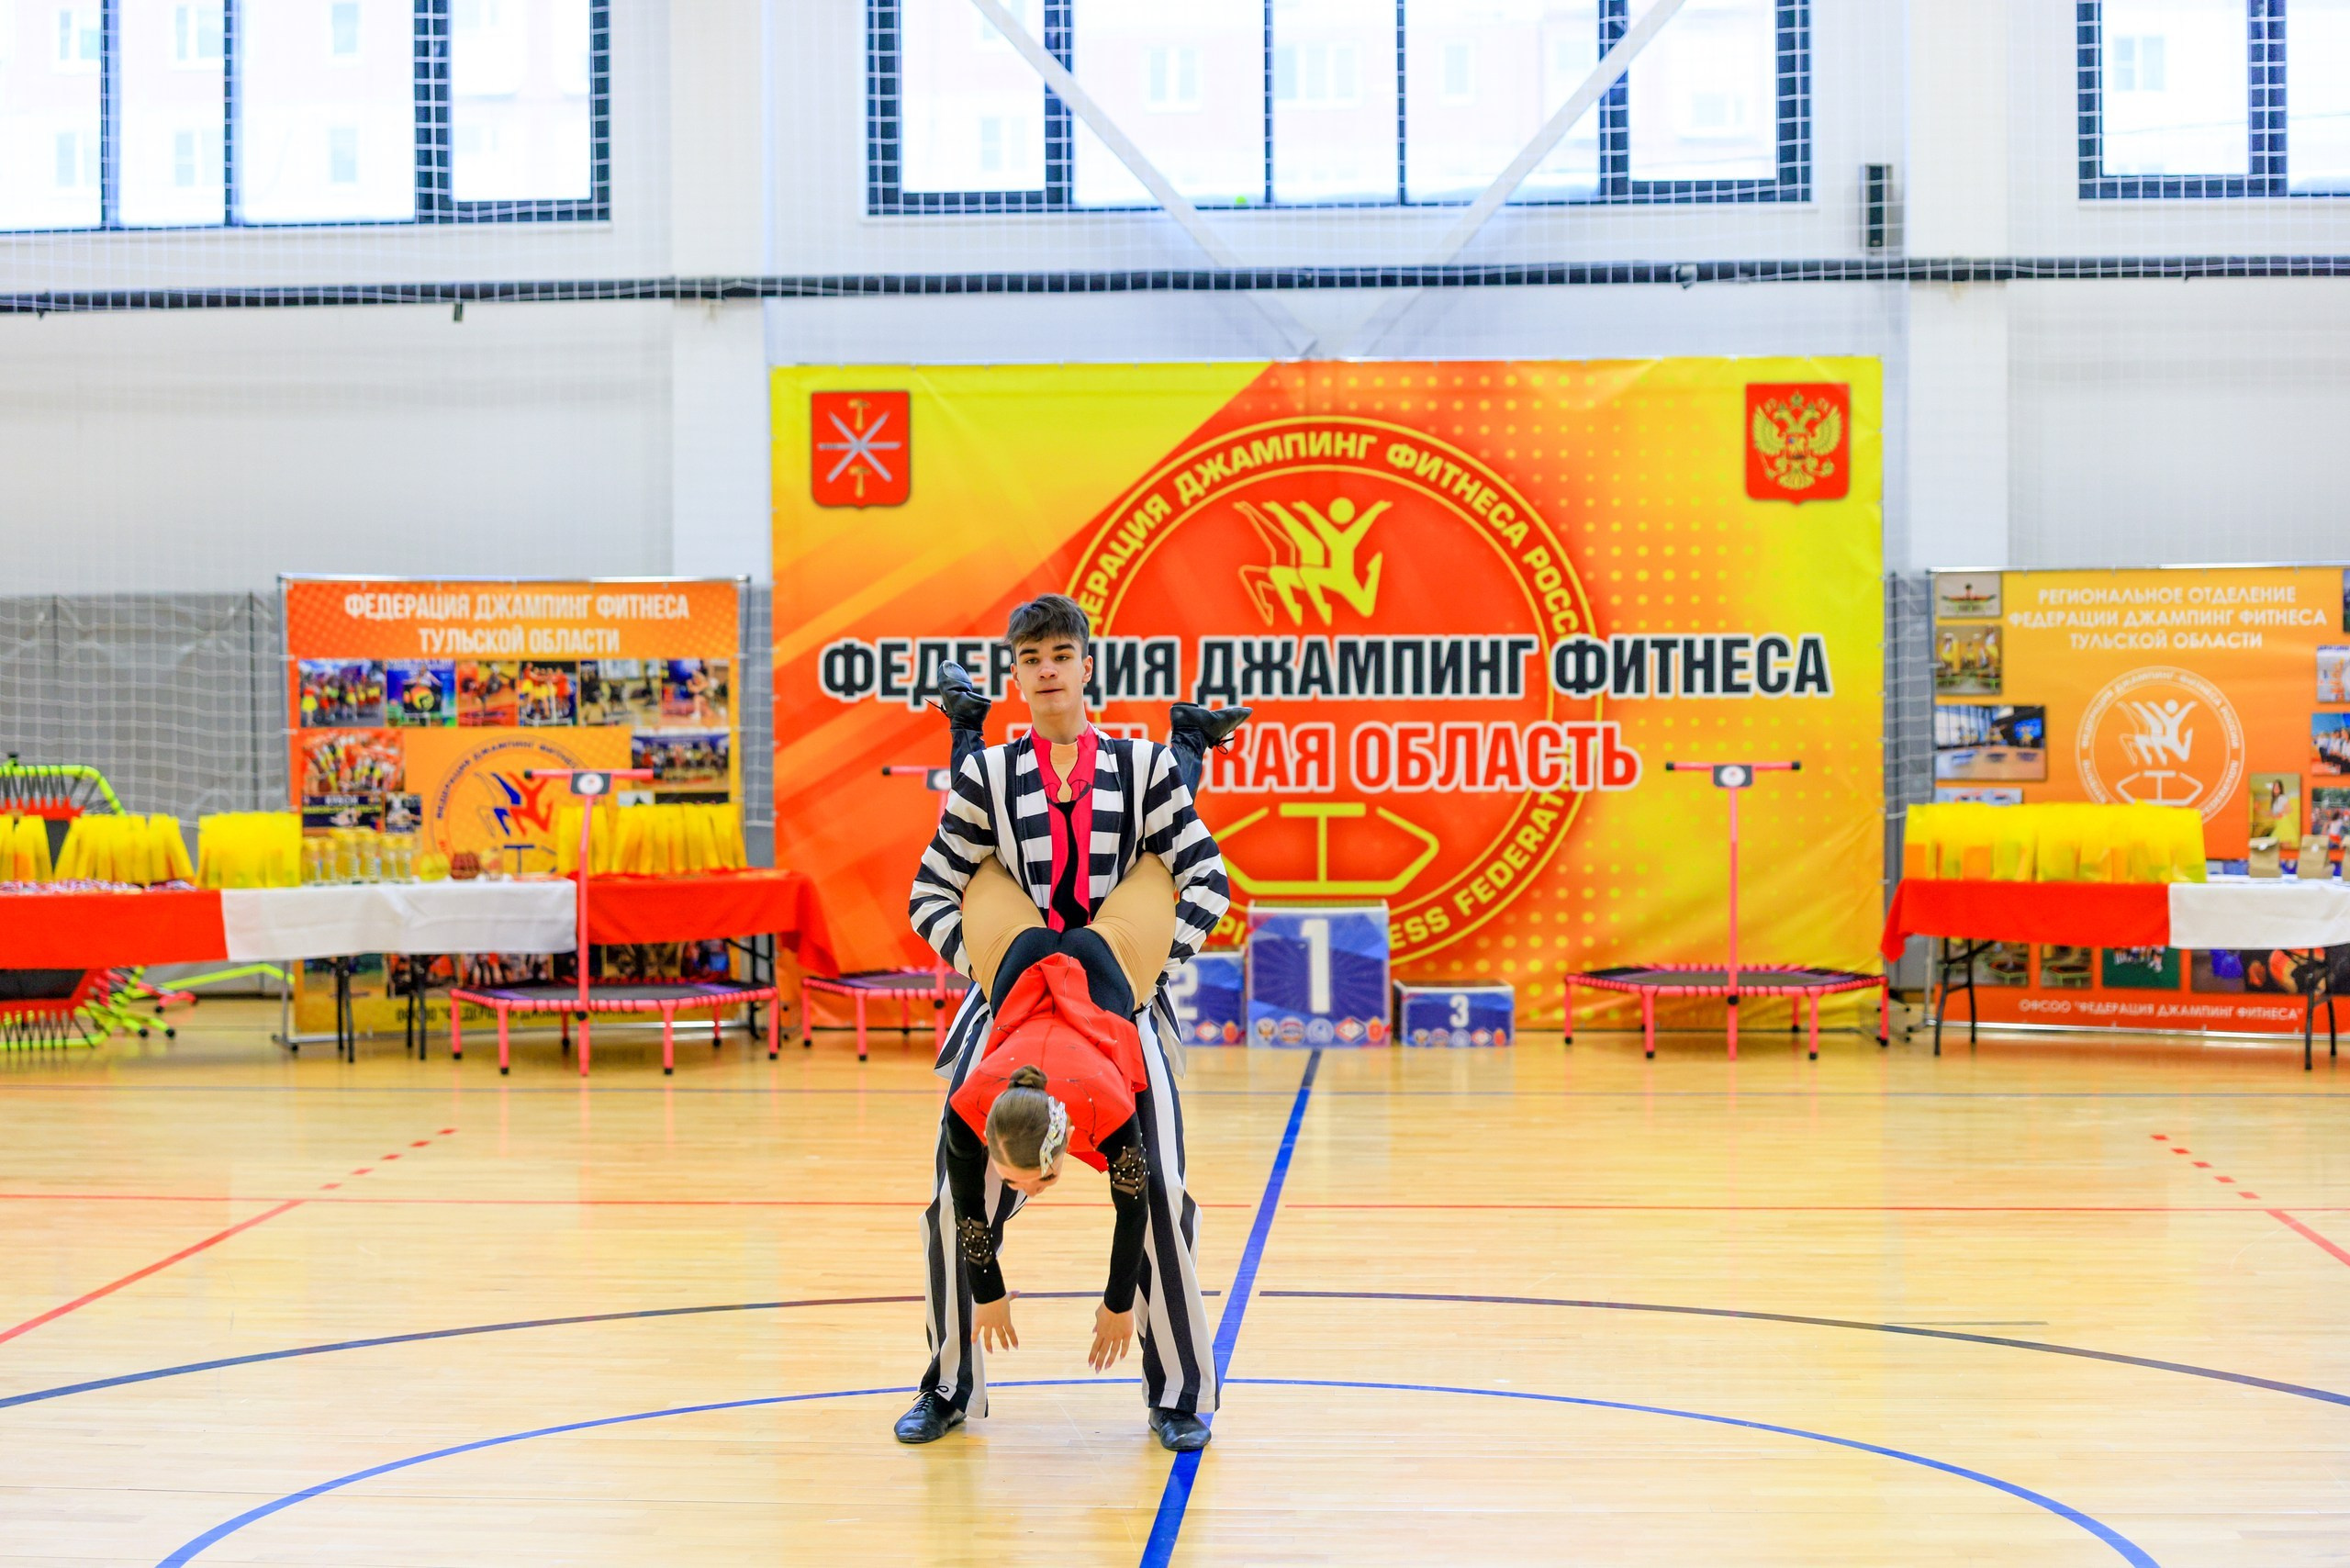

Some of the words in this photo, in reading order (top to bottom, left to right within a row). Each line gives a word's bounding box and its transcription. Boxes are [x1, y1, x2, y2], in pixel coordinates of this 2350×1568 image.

[1173, 431, 1378, 507] ДЖАМПИНГ
[1385, 443, 1530, 549] ФИТНЕСА
[1521, 543, 1581, 641] РОСС
[343, 593, 470, 621] ФЕДЕРАЦИЯ
[473, 593, 592, 621] ДЖАМПИНГ
[596, 592, 689, 620] ФИТНЕСА
[2037, 587, 2188, 606] РЕГИОНАЛЬНОЕ
[2192, 586, 2297, 605] ОТДЕЛЕНИЕ
[2008, 610, 2120, 628] ФЕДЕРАЦИИ
[2123, 610, 2233, 627] ДЖАМПИНГ
[2239, 608, 2328, 626] ФИТНЕСА
[419, 624, 523, 655] ТУЛЬСКОЙ
[529, 626, 621, 654] ОБЛАСТИ
[2069, 630, 2169, 650] ТУЛЬСКОЙ
[2173, 632, 2264, 649] ОБЛАСТИ
[1196, 638, 1537, 706] ДЖАМПИНГ
[1553, 637, 1831, 697] ФИТНЕСА
[1353, 723, 1639, 791] ОБЛАСТЬ
[1300, 917, 1331, 1014] 1
[1169, 964, 1198, 1021] 2
[1449, 994, 1470, 1027] 3
